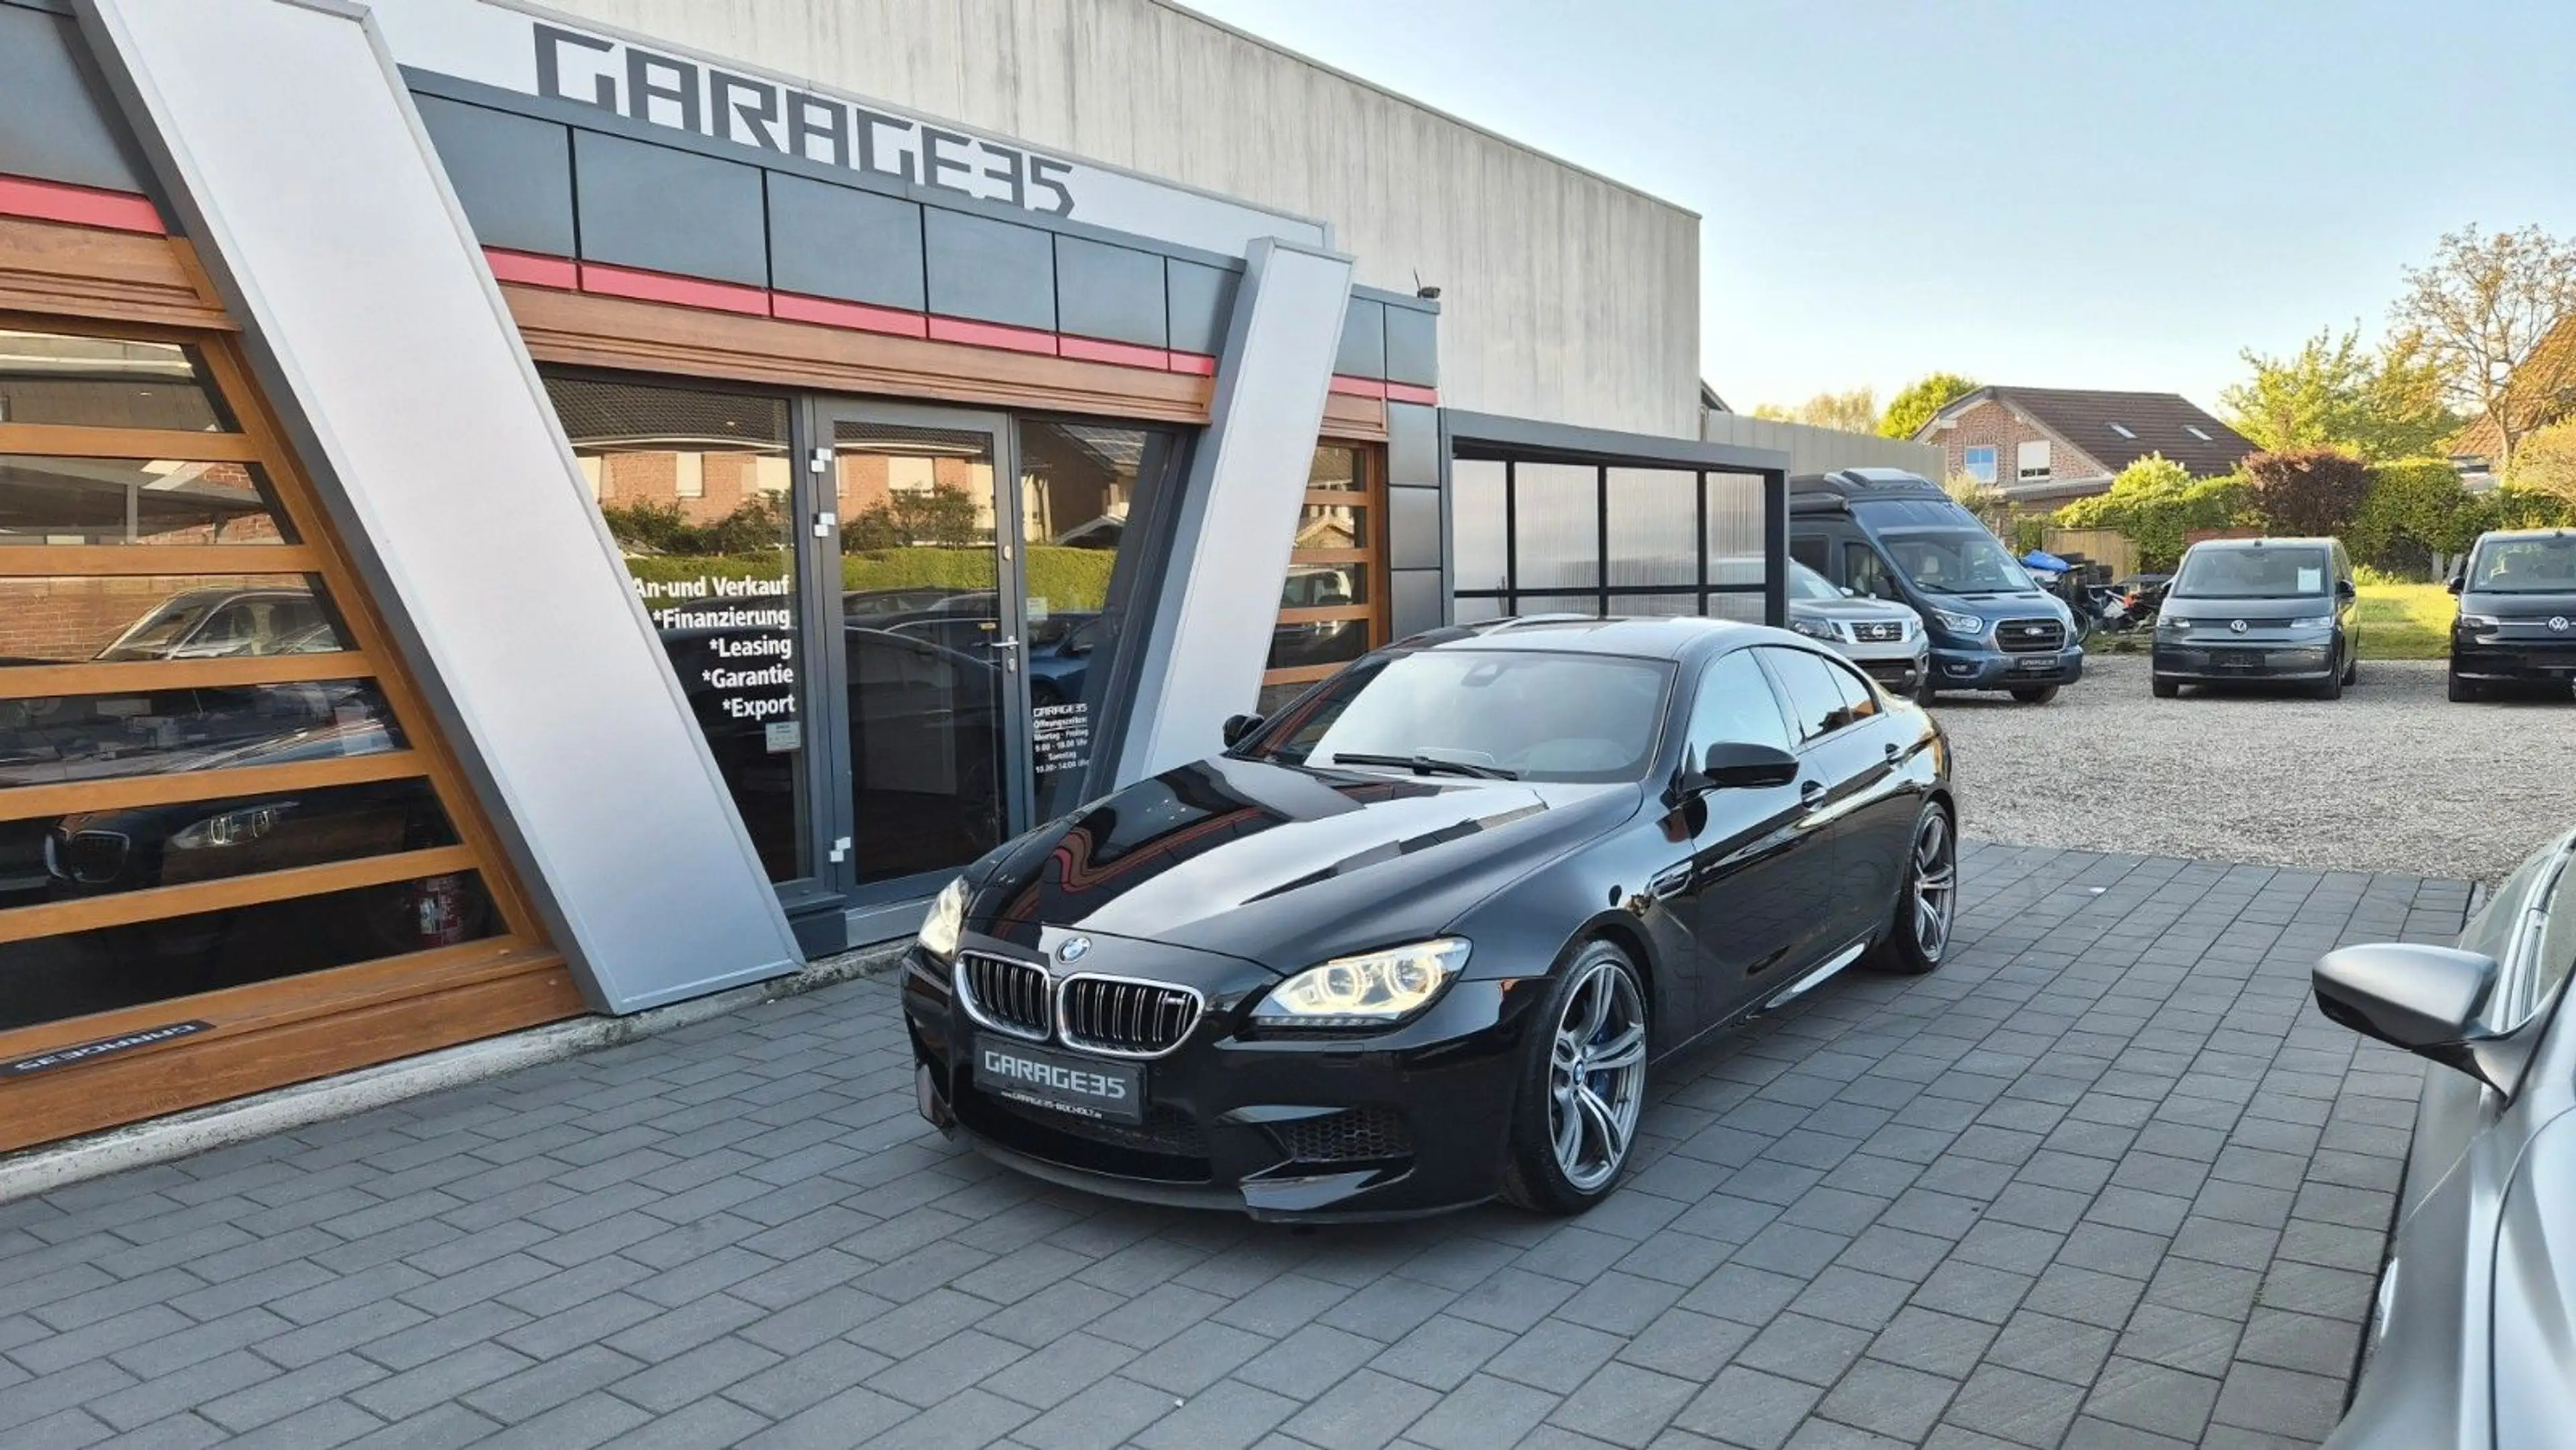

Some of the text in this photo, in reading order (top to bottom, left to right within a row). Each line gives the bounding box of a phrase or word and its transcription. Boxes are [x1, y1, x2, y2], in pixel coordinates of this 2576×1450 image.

[533, 21, 1075, 219] GARAGE35
[633, 574, 790, 598] An-und Verkauf
[985, 1050, 1126, 1100] GARAGE35
